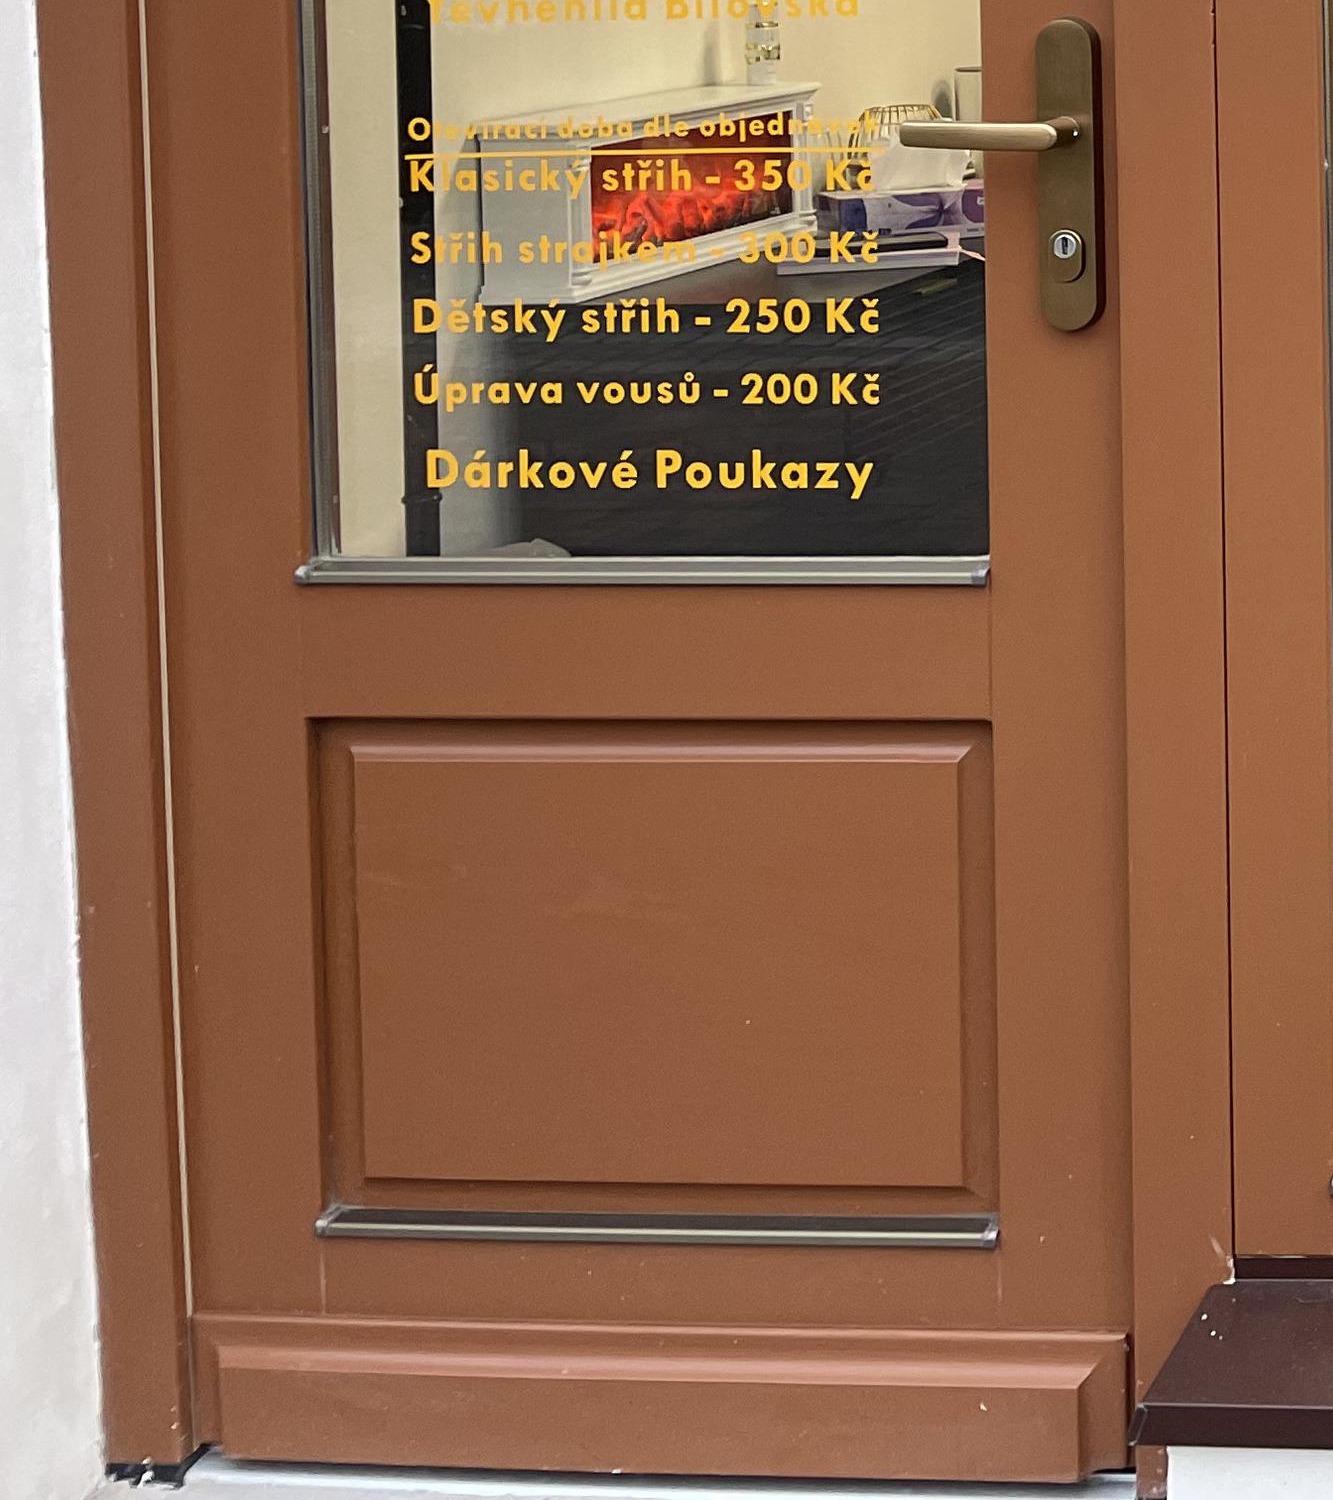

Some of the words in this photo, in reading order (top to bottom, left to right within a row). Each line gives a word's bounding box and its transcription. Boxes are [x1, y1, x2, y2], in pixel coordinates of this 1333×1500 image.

[557, 115, 633, 140] doba
[643, 114, 690, 138] dle
[410, 159, 588, 200] Klasický
[602, 159, 692, 192] střih
[734, 159, 812, 192] 350
[826, 159, 876, 192] Kč
[410, 231, 503, 265] Střih
[738, 232, 817, 264] 300
[829, 231, 880, 264] Kč
[413, 297, 566, 342] Dětský
[581, 297, 680, 334] střih
[725, 298, 811, 334] 250
[825, 297, 880, 334] Kč
[413, 363, 563, 412] Úprava
[576, 372, 701, 405] vousů
[740, 373, 818, 405] 200
[831, 372, 880, 405] Kč
[426, 448, 638, 489] Dárkové
[656, 448, 875, 500] Poukazy
